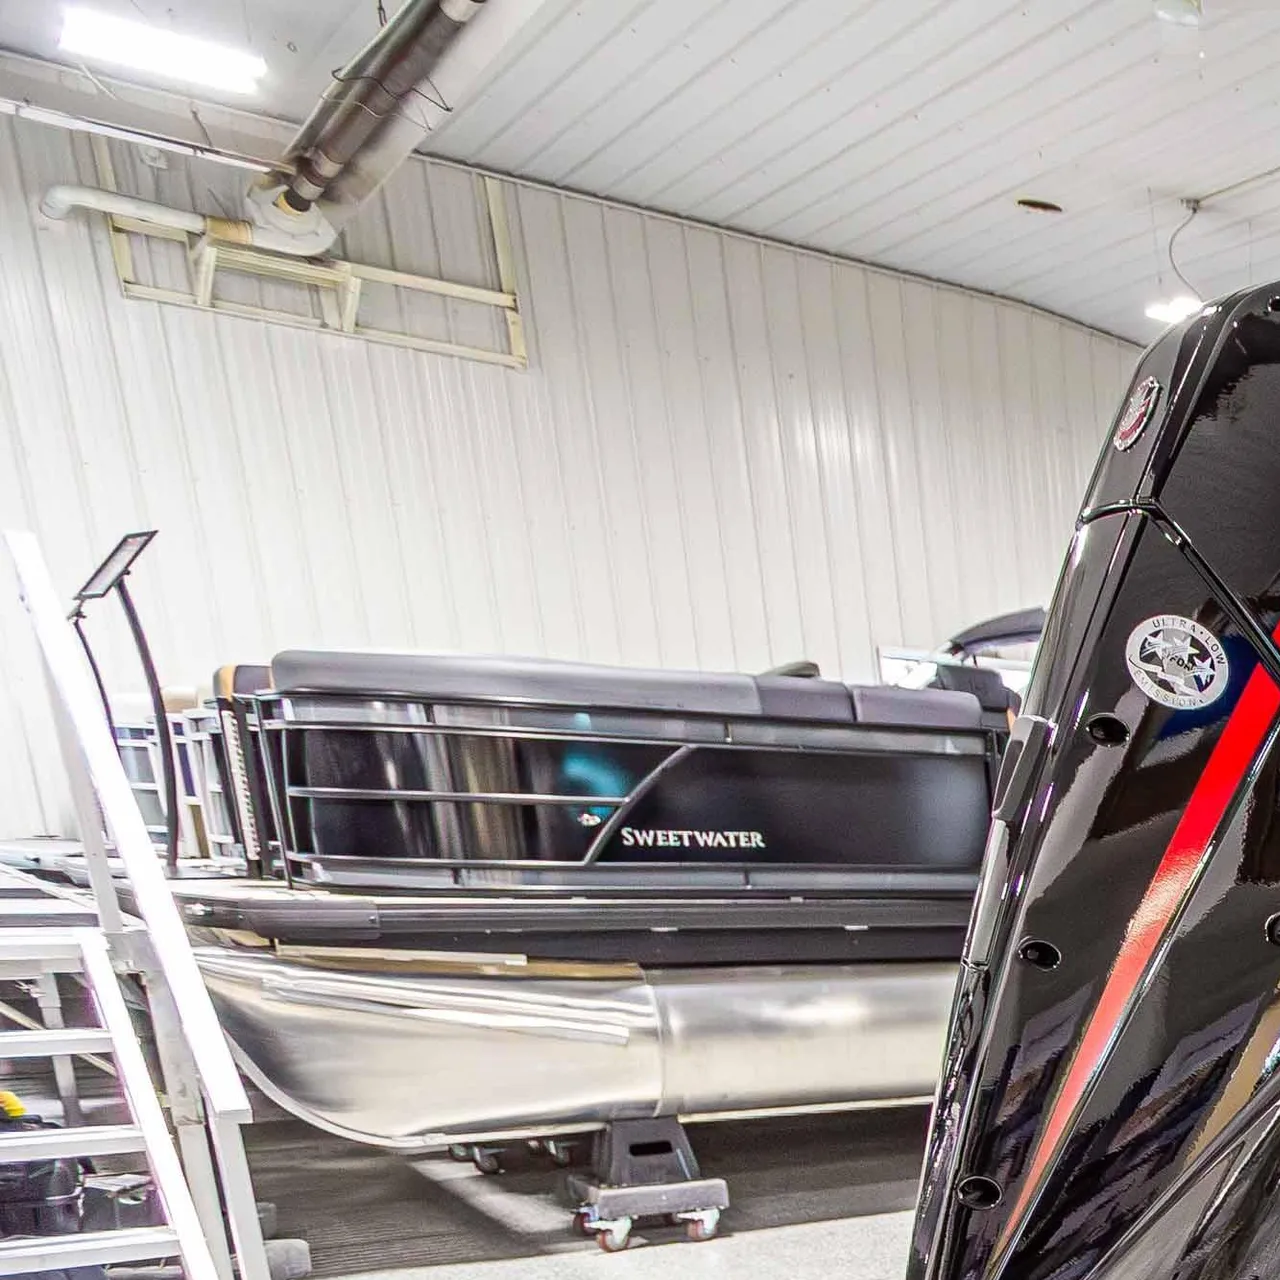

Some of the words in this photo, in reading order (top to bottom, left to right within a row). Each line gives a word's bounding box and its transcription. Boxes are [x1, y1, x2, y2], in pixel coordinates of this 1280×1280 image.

[1152, 619, 1197, 633] ULTRA
[1204, 636, 1226, 665] LOW
[620, 827, 767, 848] SWEETWATER
